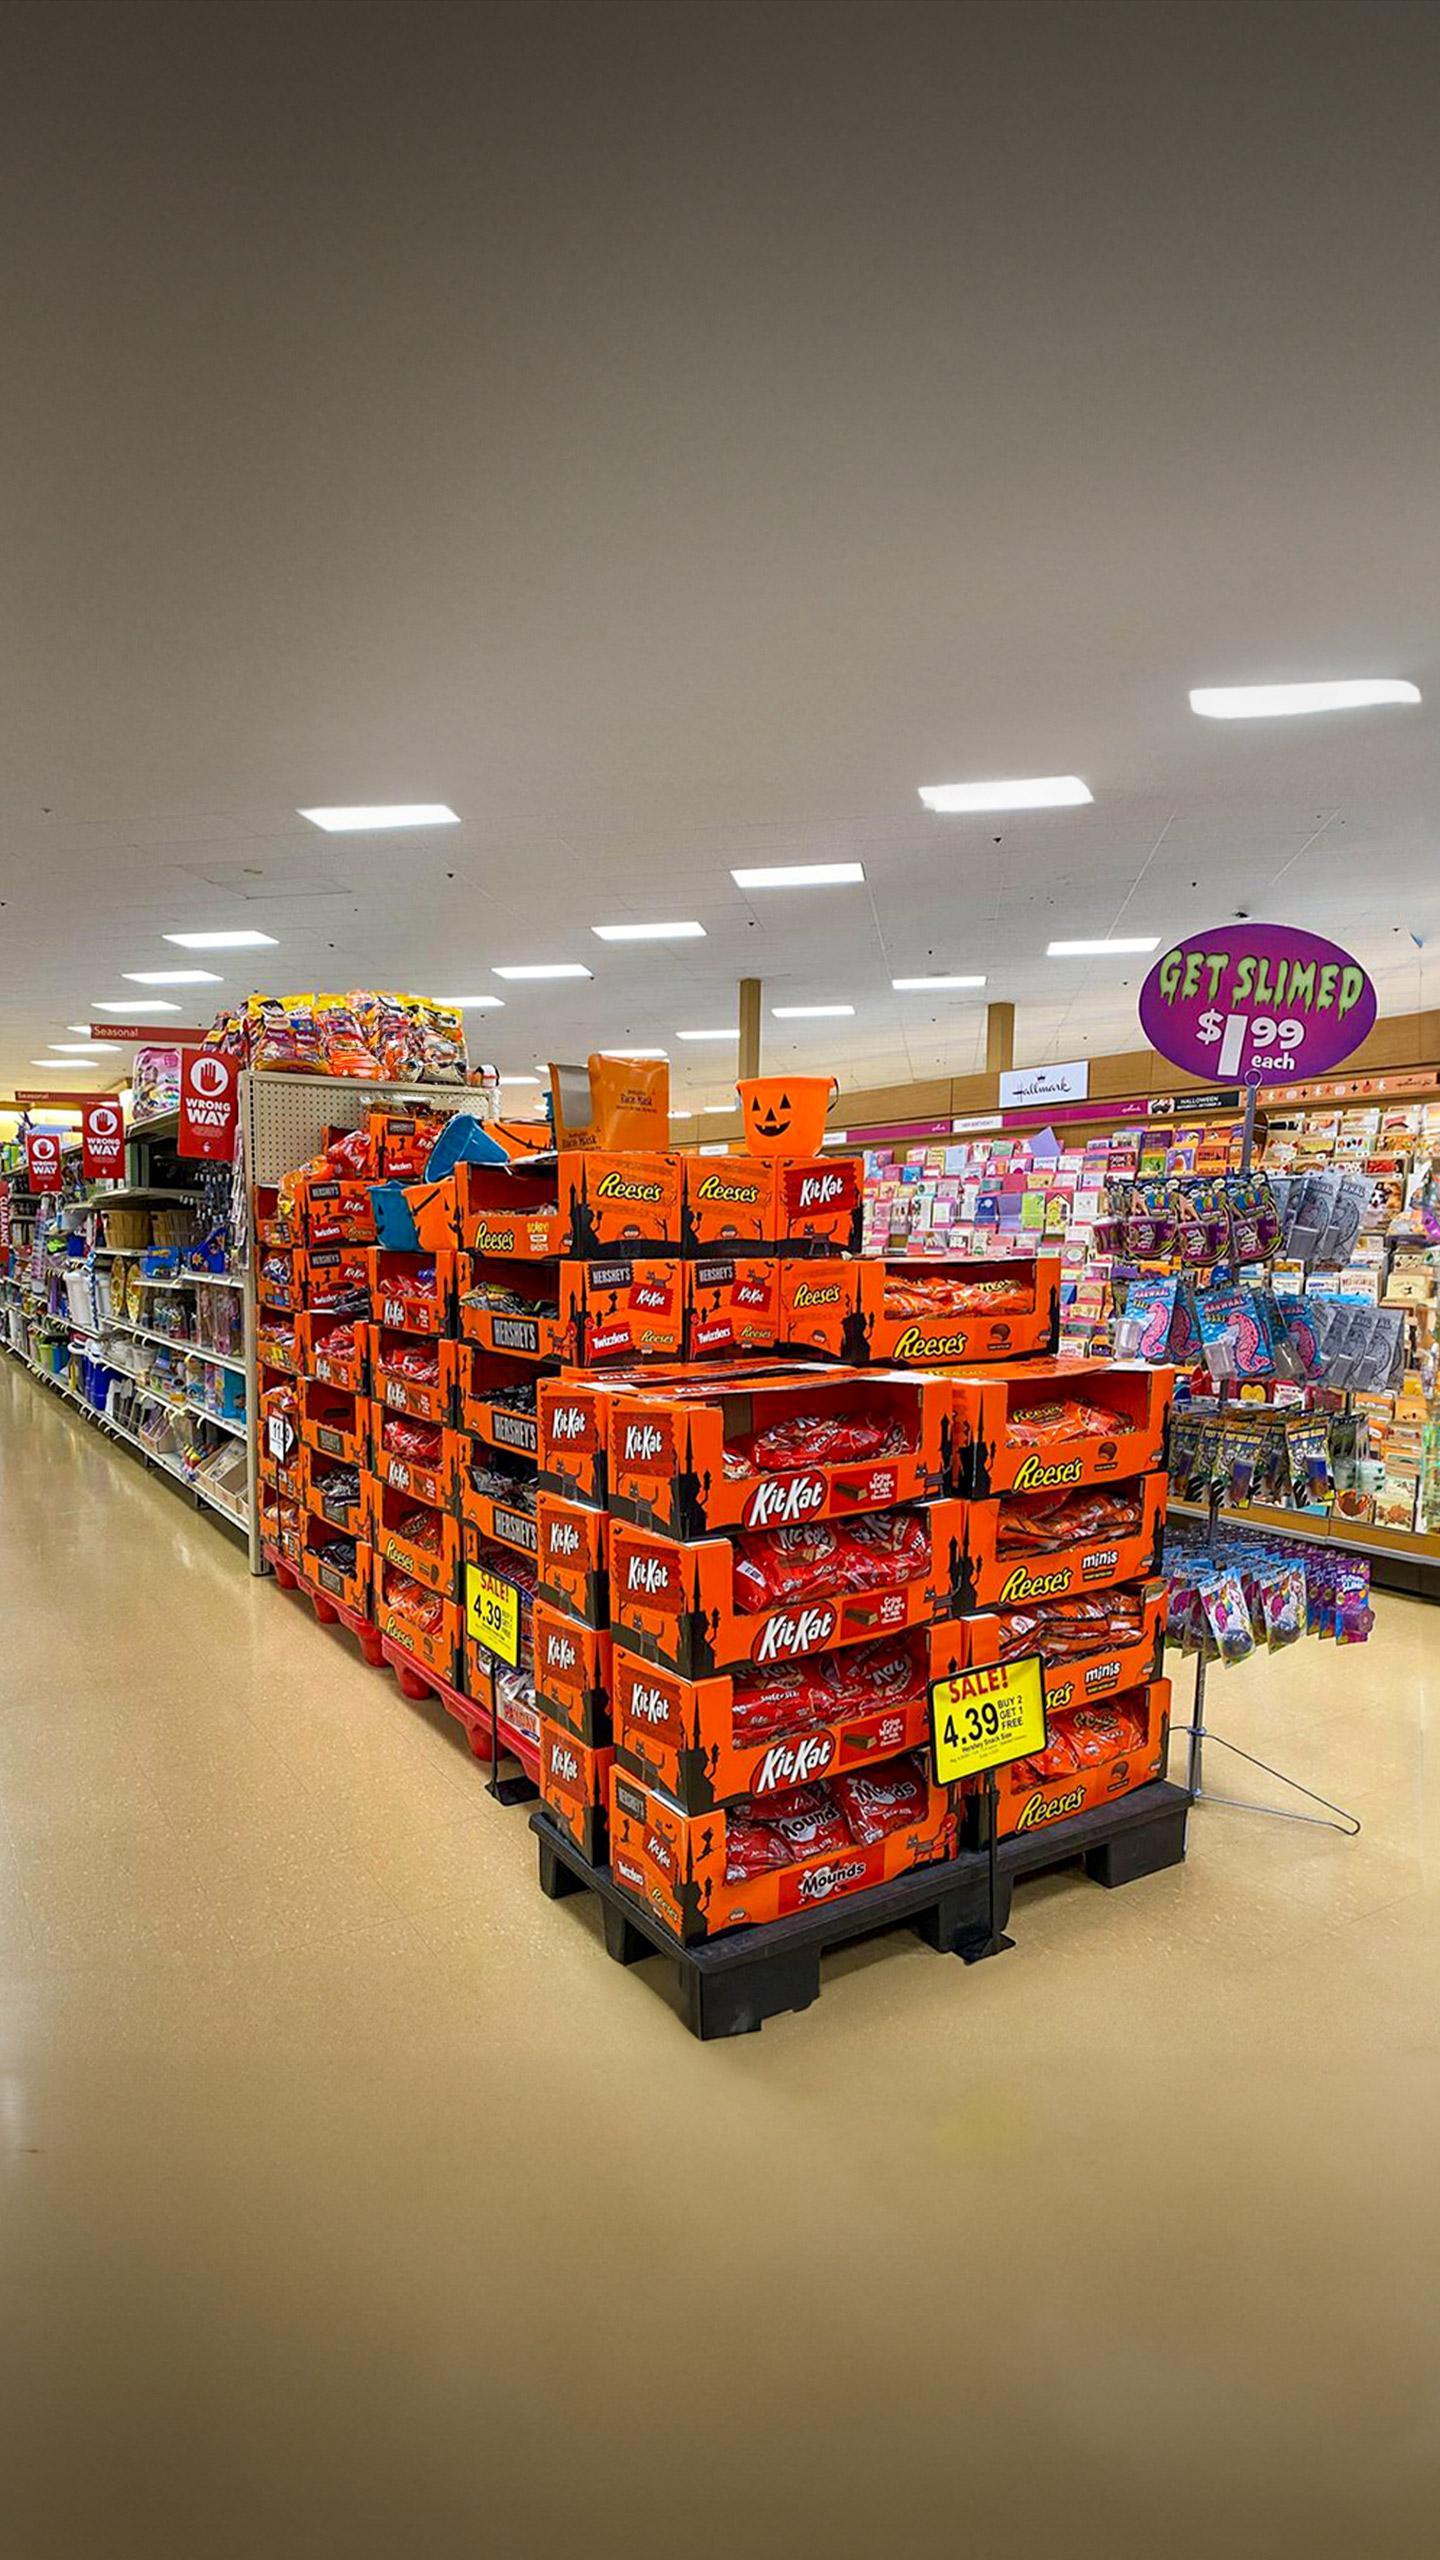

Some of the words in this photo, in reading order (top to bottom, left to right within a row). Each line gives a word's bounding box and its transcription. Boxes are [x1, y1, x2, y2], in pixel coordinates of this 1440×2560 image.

[1159, 949, 1230, 1007] GET
[1231, 955, 1365, 1021] SLIMED
[94, 1026, 139, 1038] Seasonal
[1251, 1053, 1296, 1070] each
[18, 1092, 50, 1100] Seasonal
[1013, 1079, 1072, 1103] Hallmark
[186, 1098, 231, 1112] WRONG
[186, 1108, 230, 1126] WAY
[86, 1136, 121, 1147] WRONG
[87, 1143, 120, 1157] WAY
[31, 1160, 58, 1169] WRONG
[32, 1165, 57, 1176] WAY
[598, 1172, 662, 1201] Reese's
[698, 1176, 758, 1202] Reese's
[475, 1221, 514, 1251] Reese's
[592, 1266, 631, 1283] HERSHEY'S
[699, 1265, 733, 1282] HERSHEY'S
[794, 1282, 840, 1308] Reese's
[494, 1318, 537, 1350] HERSHEY'S
[640, 1329, 673, 1344] Reese's
[741, 1325, 771, 1338] Reese's
[893, 1326, 967, 1359] Reese's
[494, 1413, 537, 1450] HERSHEY'S
[873, 1472, 892, 1484] Crisp
[1012, 1454, 1083, 1490] Reese's
[868, 1480, 895, 1490] Wafers
[495, 1508, 538, 1549] HERSHEY'S
[387, 1539, 414, 1572] Reese's
[1082, 1551, 1118, 1569] minis
[480, 1570, 510, 1605] SALE!
[1000, 1568, 1072, 1604] Reese's
[879, 1602, 906, 1613] Wafers
[883, 1595, 903, 1606] Crisp
[474, 1594, 502, 1630] 4.39
[386, 1615, 414, 1651] Reese's
[1085, 1661, 1121, 1683] minis
[948, 1666, 1009, 1704] SALE!
[1045, 1682, 1074, 1710] se's
[997, 1697, 1015, 1709] BUY
[1017, 1695, 1023, 1704] 2
[1000, 1708, 1017, 1720] GET
[1018, 1706, 1024, 1715] 1
[943, 1702, 999, 1748] 4.39
[1001, 1717, 1024, 1731] FREE
[1017, 1786, 1085, 1832] Reese's
[800, 1860, 866, 1895] Mounds
